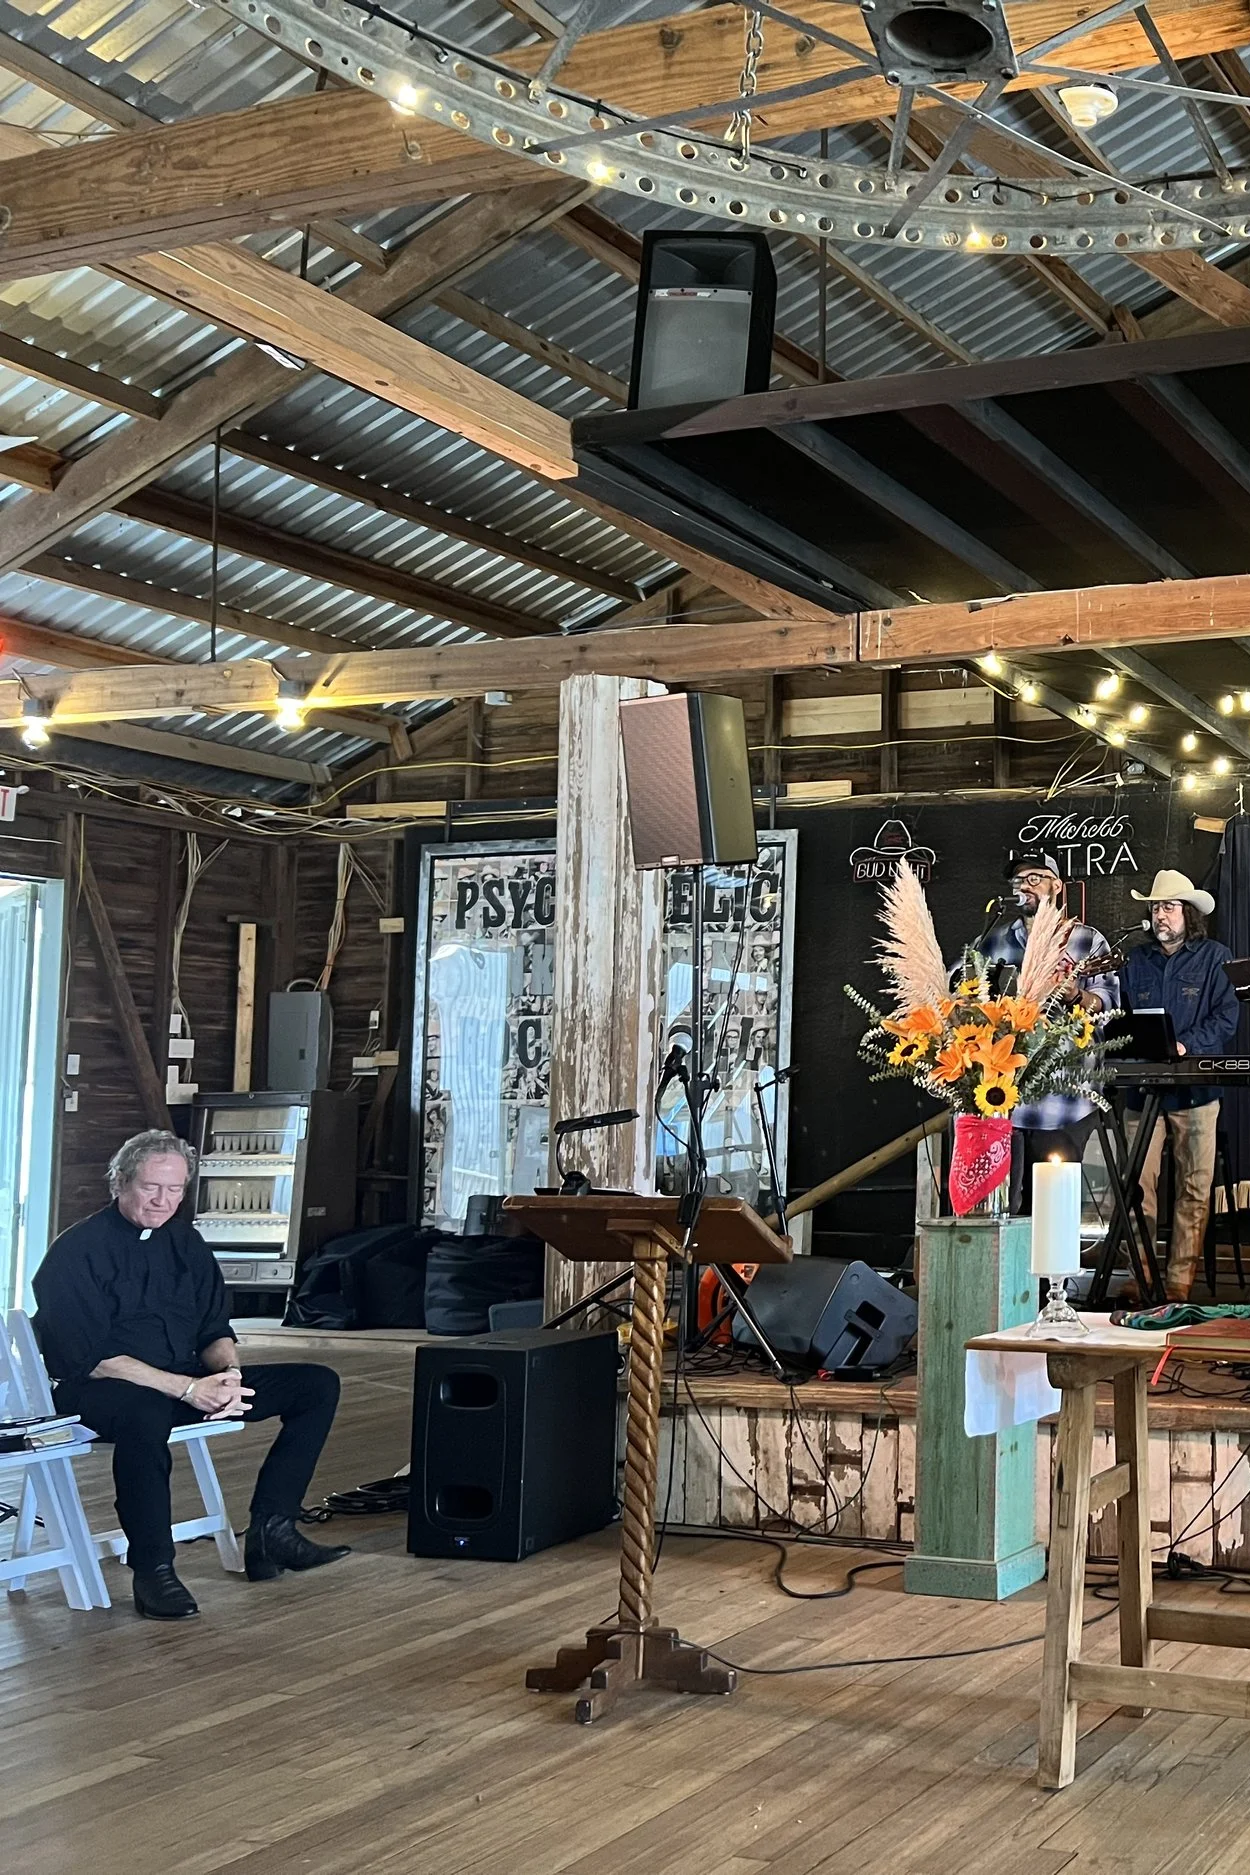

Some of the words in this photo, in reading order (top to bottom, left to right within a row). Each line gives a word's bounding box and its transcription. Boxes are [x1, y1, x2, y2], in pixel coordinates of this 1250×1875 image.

[1018, 812, 1129, 843] Michelob
[856, 862, 886, 879] BUD
[1009, 841, 1139, 877] TRA
[1198, 1059, 1250, 1070] CK88
